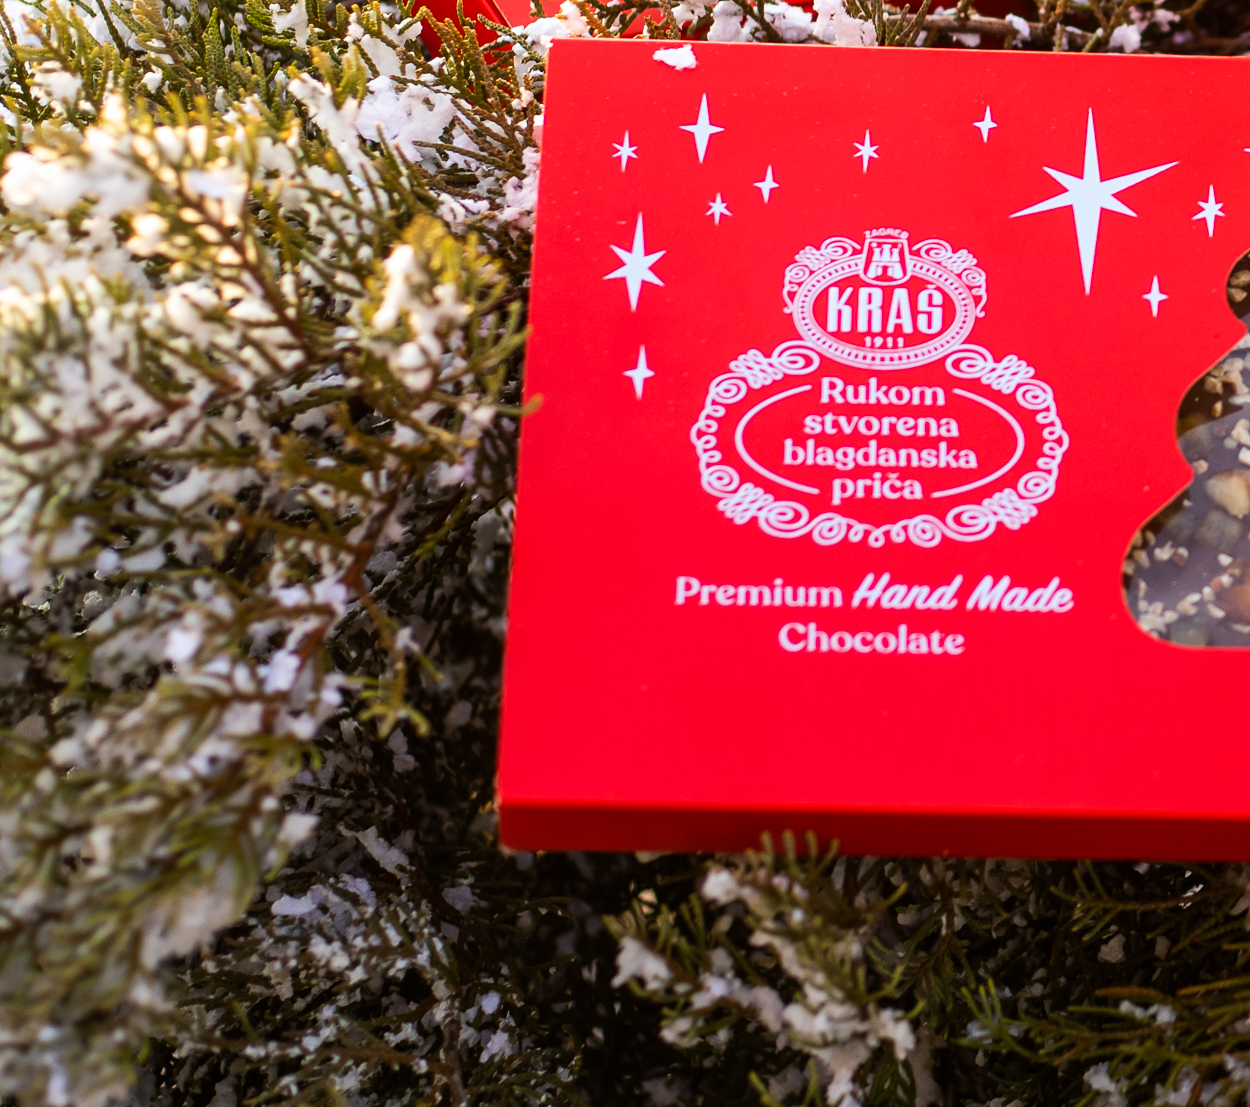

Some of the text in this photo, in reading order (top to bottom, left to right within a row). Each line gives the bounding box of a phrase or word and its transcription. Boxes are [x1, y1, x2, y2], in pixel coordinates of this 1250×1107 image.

[826, 284, 943, 334] KRAŠ
[864, 336, 904, 348] 1911
[820, 377, 945, 406] Rukom
[803, 412, 959, 437] stvorena
[783, 438, 978, 470] blagdanska
[831, 472, 923, 505] priča
[674, 572, 1074, 613] Premium Hand Made
[778, 623, 965, 655] Chocolate
